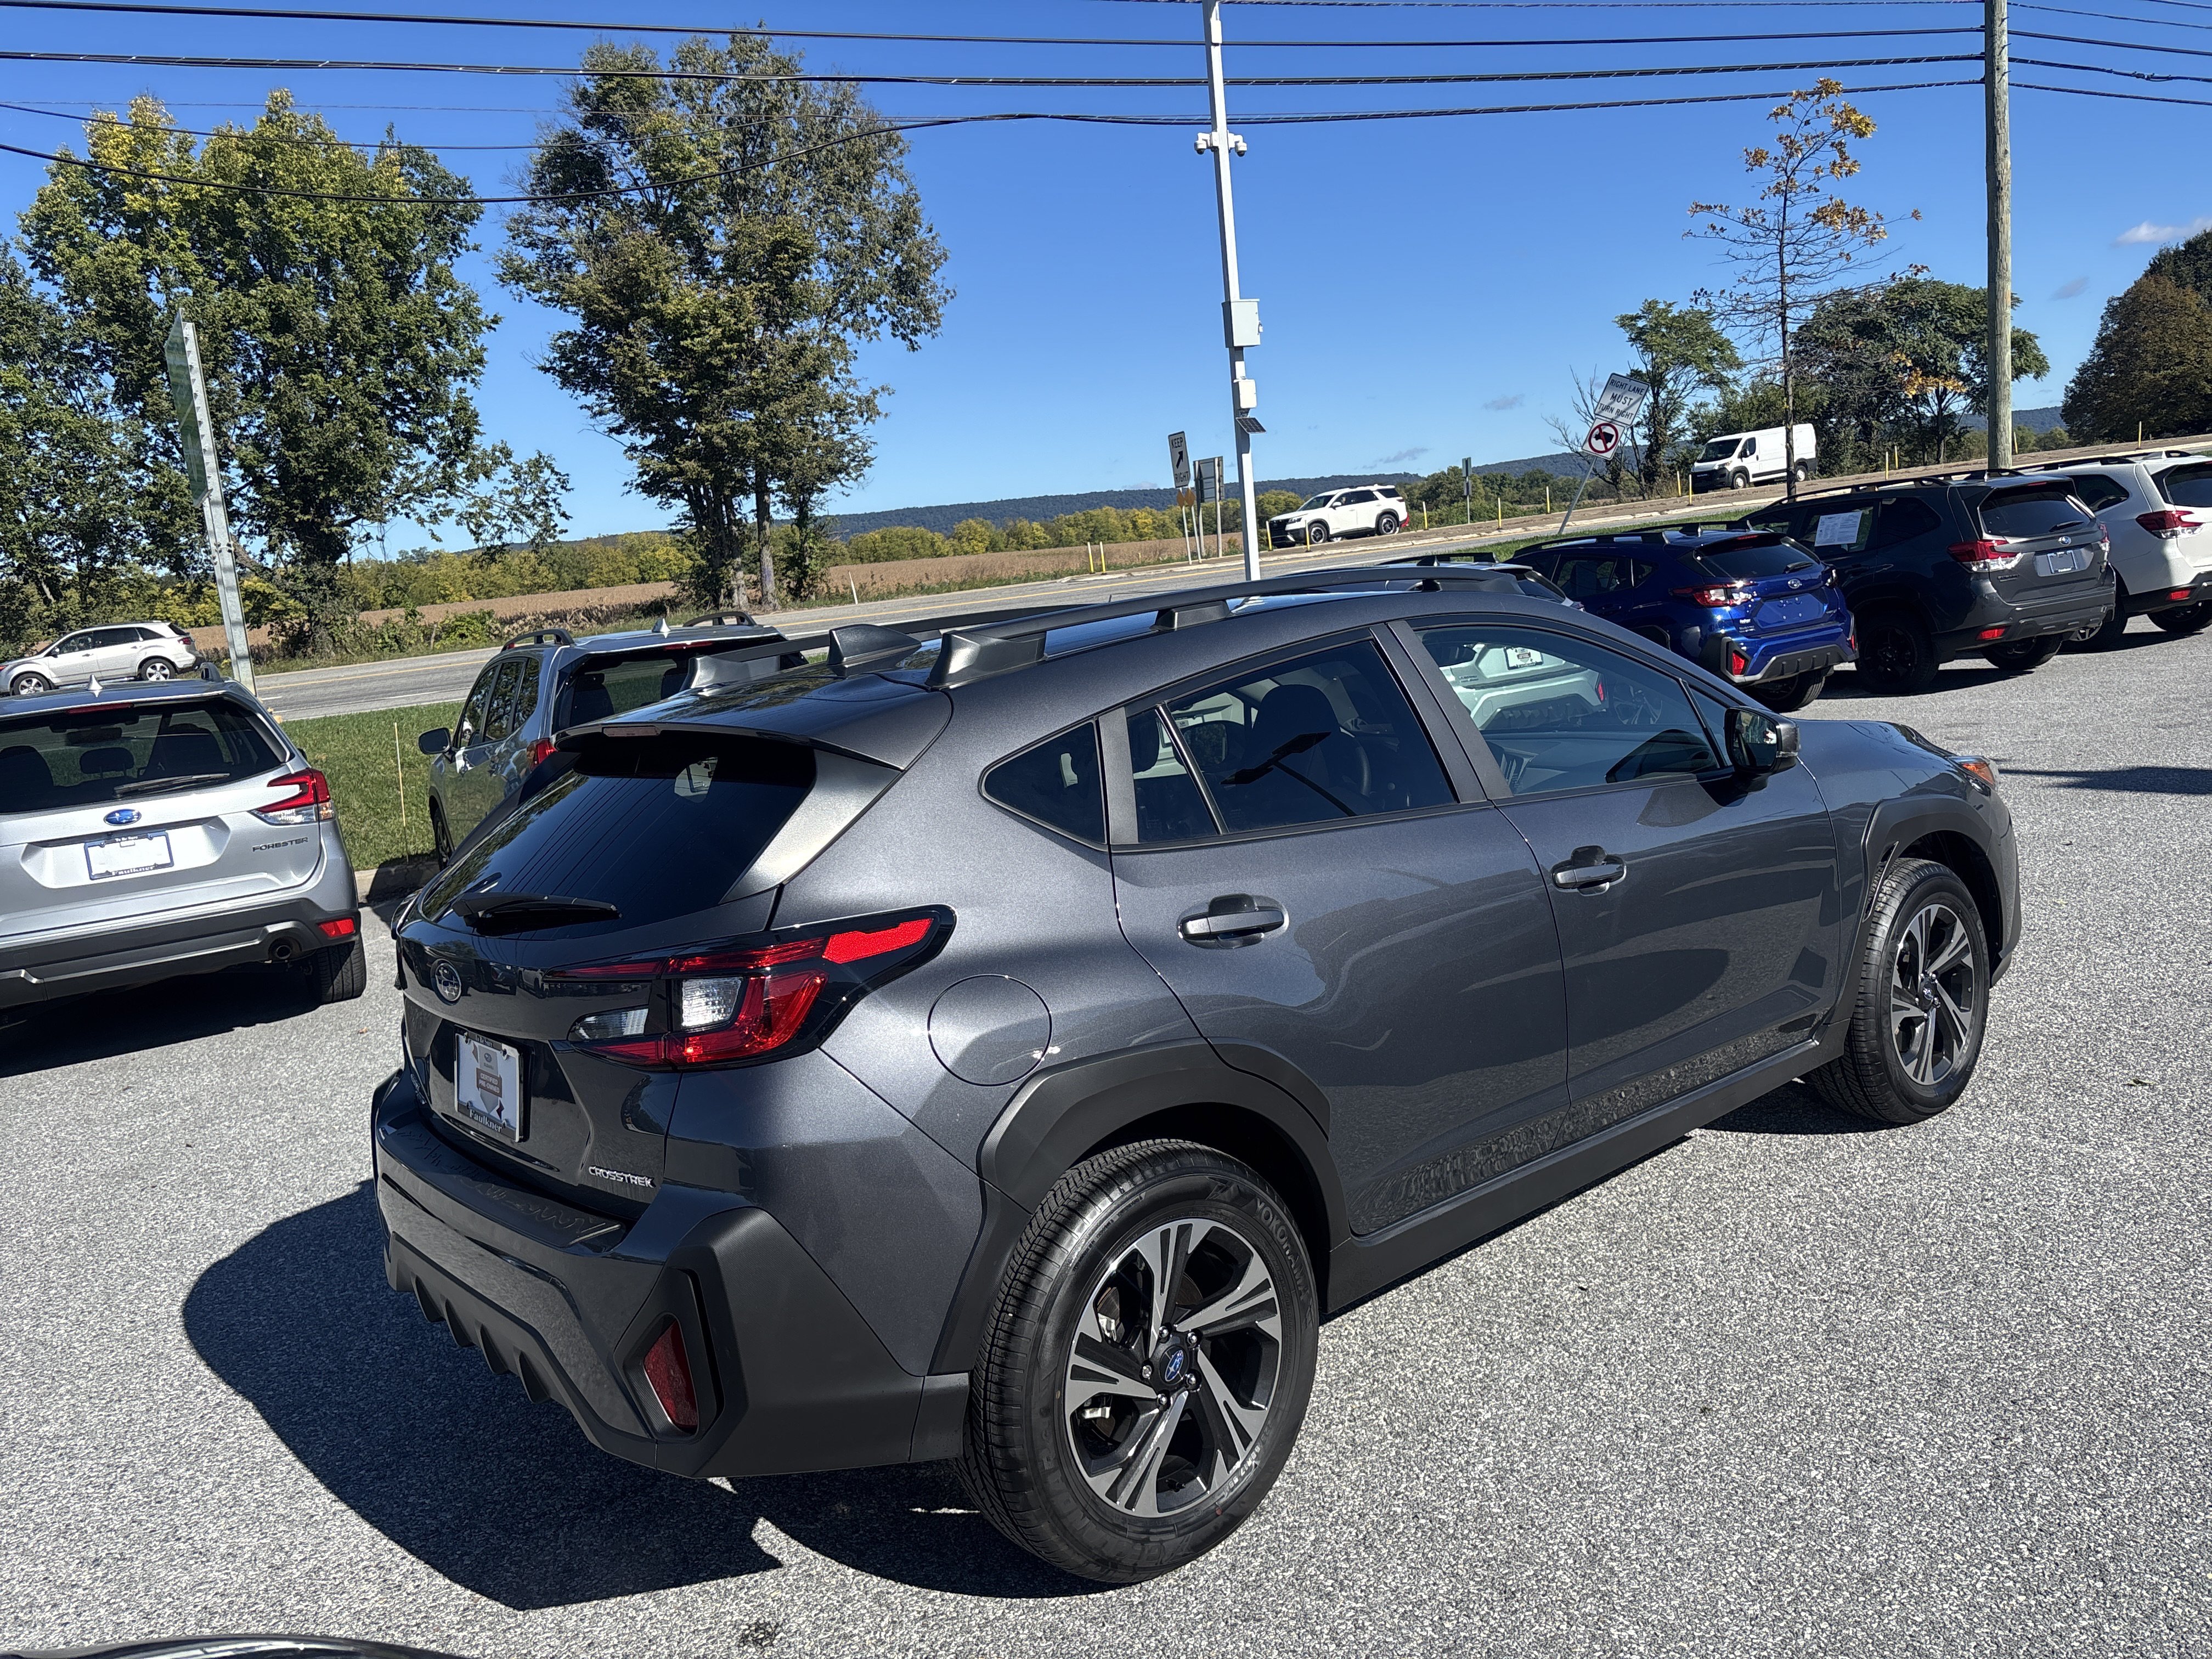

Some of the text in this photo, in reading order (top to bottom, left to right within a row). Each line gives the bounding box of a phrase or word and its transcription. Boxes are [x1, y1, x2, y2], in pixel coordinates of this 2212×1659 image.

[1609, 379, 1645, 395] RIGHT LANE
[1610, 392, 1633, 406] MUST
[1598, 403, 1634, 420] TURN RIGHT
[1171, 437, 1183, 449] KEEP
[1175, 471, 1189, 483] RIGHT
[252, 837, 308, 851] FORESTER
[480, 1073, 498, 1085] CERTIFIED
[478, 1080, 500, 1093] PRE-OWNED
[469, 1109, 503, 1133] Faulkner
[588, 1166, 655, 1188] CROSSTREK
[1256, 1198, 1309, 1300] YOKOHAMA
